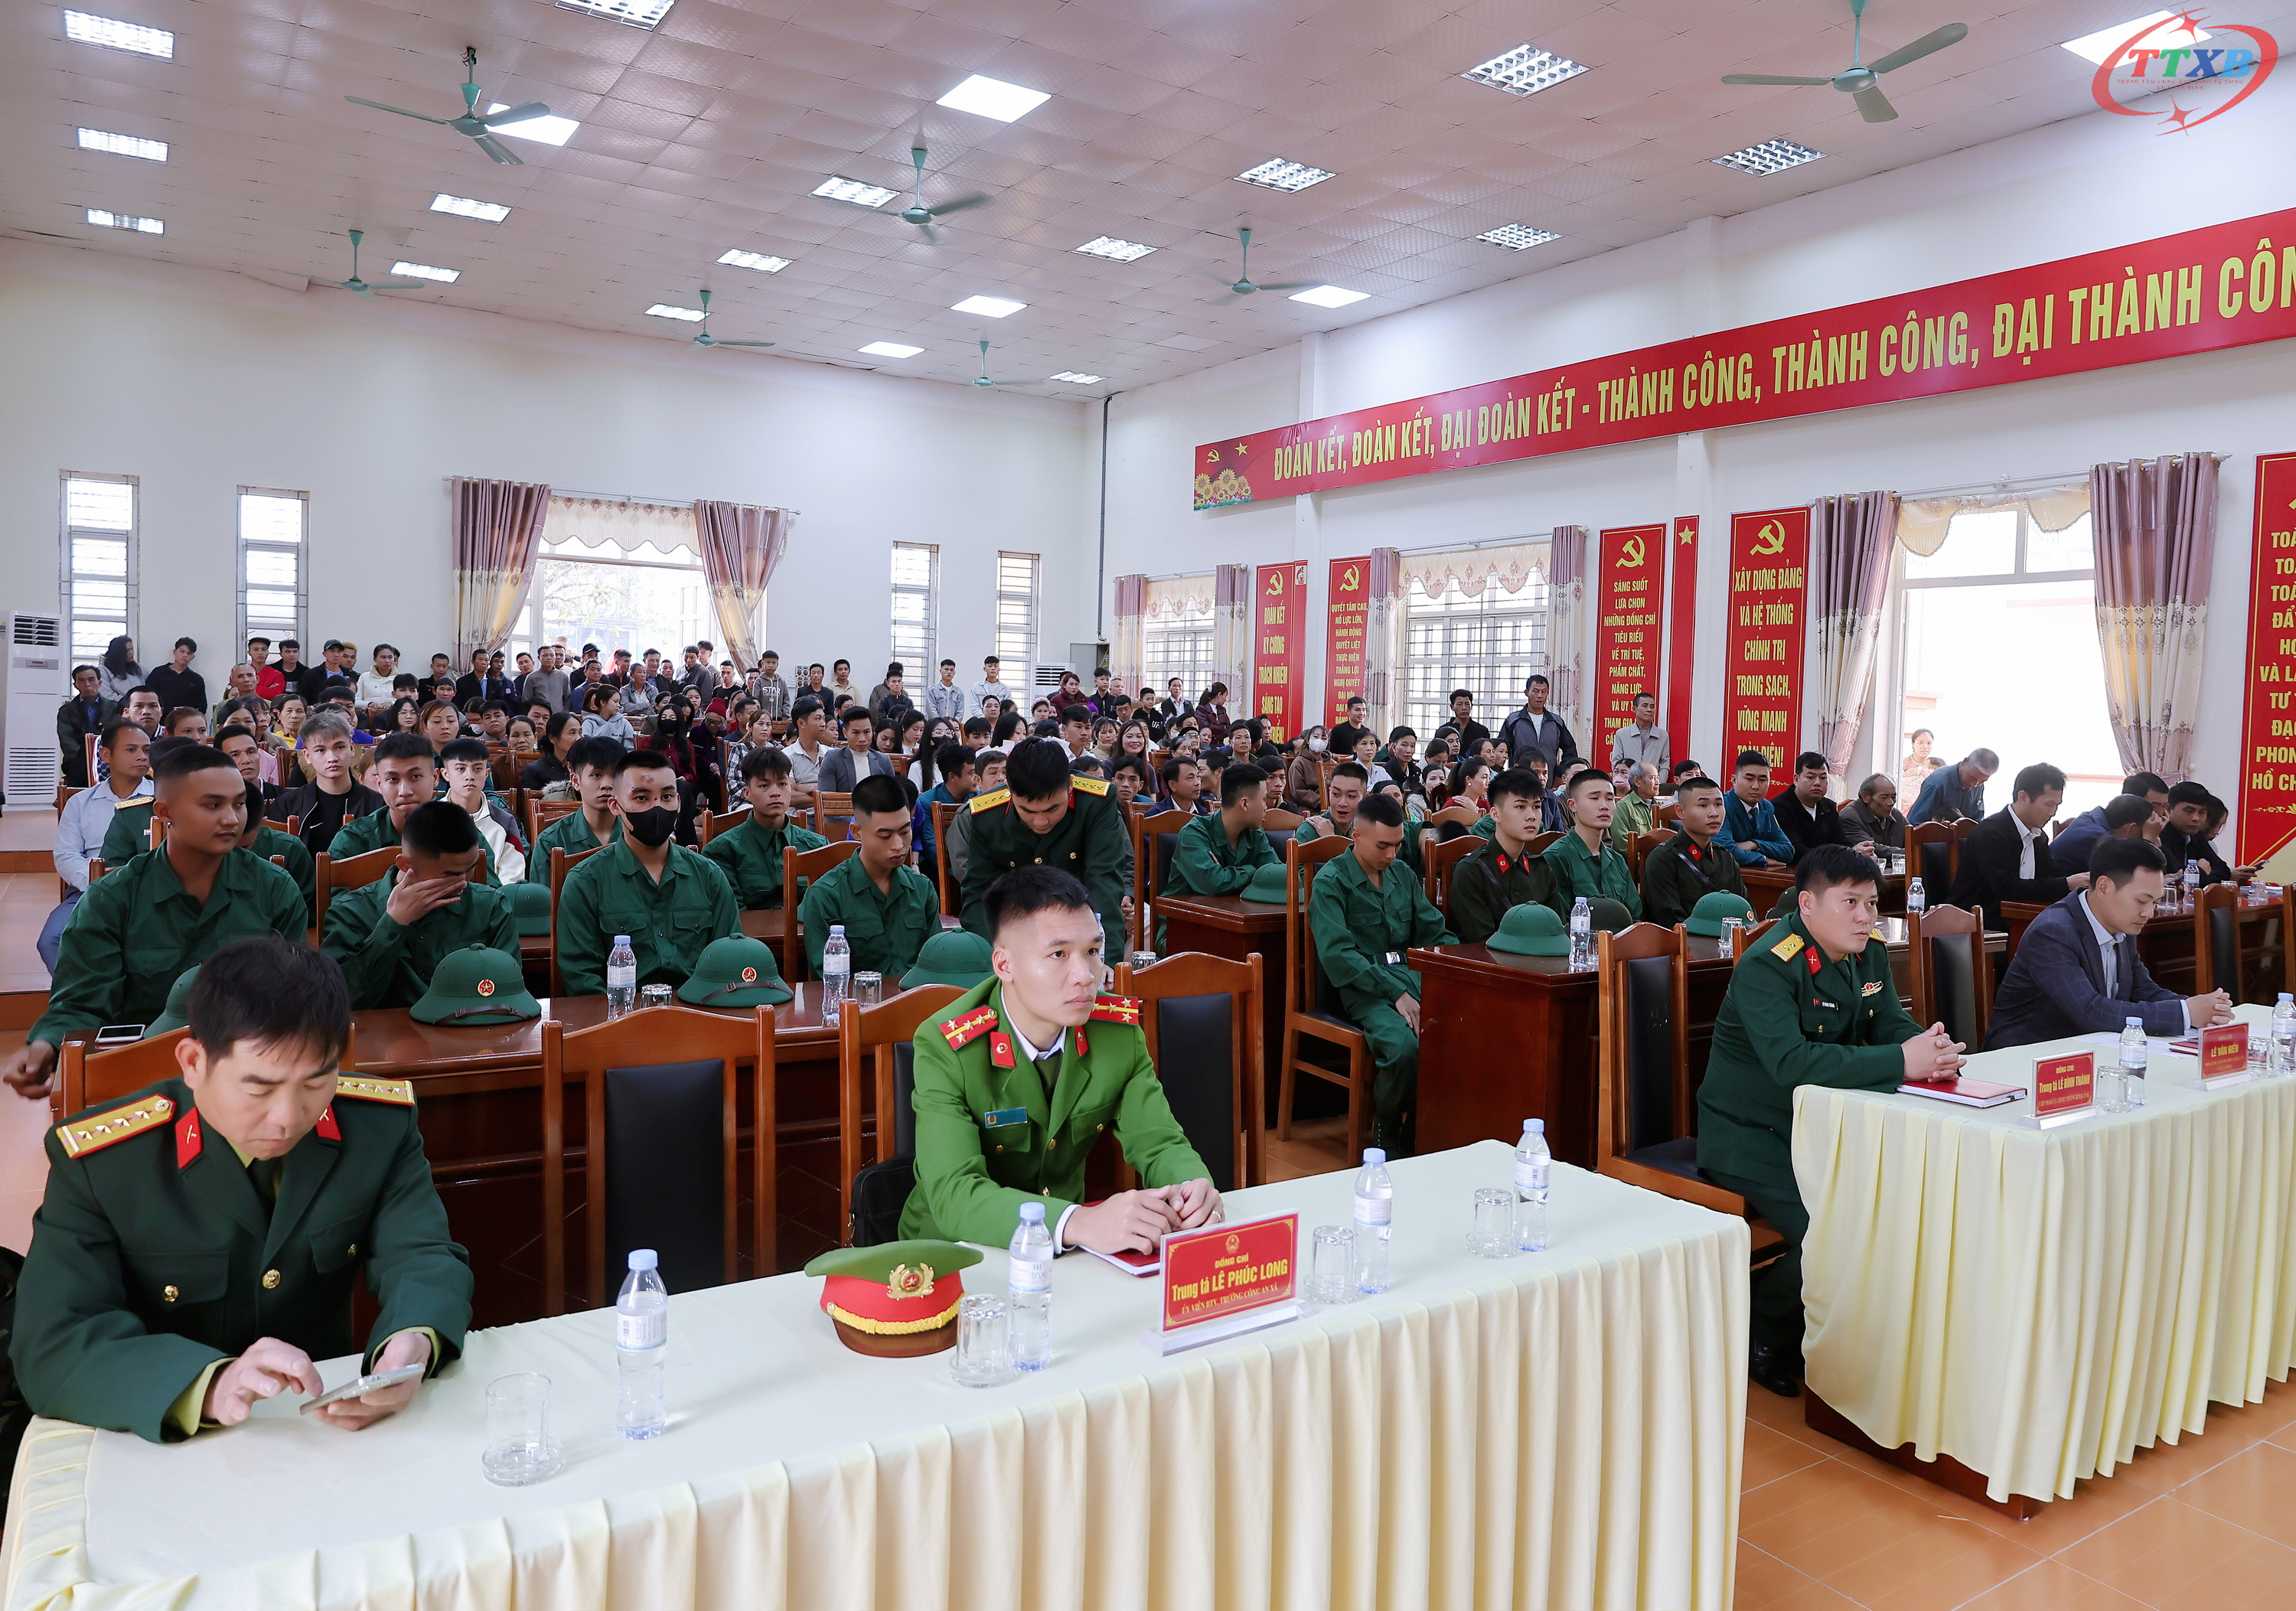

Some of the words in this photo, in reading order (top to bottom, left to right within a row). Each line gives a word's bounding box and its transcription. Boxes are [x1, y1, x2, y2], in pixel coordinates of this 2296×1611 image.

[1274, 437, 1313, 481] ĐOÀN
[1316, 425, 1347, 474] KẾT,
[1352, 419, 1396, 467] ĐOÀN
[1401, 406, 1435, 458] KẾT,
[1441, 409, 1472, 458] ĐẠI
[1477, 392, 1531, 445] ĐOÀN
[1537, 376, 1576, 435] KẾT
[1598, 366, 1675, 424] THÀNH
[1682, 350, 1761, 409] CÔNG,
[1773, 329, 1868, 394] THÀNH
[1879, 310, 1979, 377] CÔNG,
[1992, 294, 2055, 366] ĐẠI
[2068, 266, 2203, 344] THÀNH
[1613, 579, 1631, 592] SÁNG
[1632, 576, 1649, 592] SUỐT
[1734, 566, 1751, 592] XÂY
[1753, 567, 1776, 595] DỰNG
[1778, 559, 1802, 589] ĐẢNG
[1346, 602, 1356, 611] TÂM
[1615, 597, 1627, 611] LỰA
[1628, 597, 1645, 611] CHỌN
[1603, 613, 1625, 627] NHỮNG
[1626, 611, 1643, 626] ĐỒNG
[1645, 611, 1656, 625] CHÍ
[1740, 601, 1750, 626] VÀ
[1753, 600, 1763, 631] HỆ
[1766, 595, 1794, 625] THỐNG
[1614, 630, 1628, 643] TIÊU
[1629, 628, 1643, 643] BIỂU
[1611, 646, 1619, 660] VỀ
[1620, 647, 1630, 660] TRÍ
[1632, 647, 1645, 662] TUỆ,
[1744, 635, 1770, 661] CHÍNH
[1772, 639, 1786, 665] TRỊ
[1258, 662, 1273, 684] TRÁCH
[1609, 662, 1627, 677] PHẨM
[1628, 663, 1646, 678] CHẤT,
[2259, 662, 2280, 682] VÀ
[1611, 681, 1629, 694] NĂNG
[1630, 682, 1642, 696] LỰC
[1736, 674, 1763, 696] TRONG
[1765, 674, 1791, 701] SẠCH,
[1261, 692, 1274, 714] SÁNG
[1274, 696, 1283, 718] TẠO
[1611, 698, 1619, 711] VÀ
[1620, 700, 1629, 711] UY
[2269, 690, 2291, 709] TƯ
[1604, 717, 1621, 728] THAM
[1623, 718, 1633, 728] GIA
[1737, 704, 1760, 732] VỮNG
[1761, 710, 1788, 736] MẠNH
[2252, 768, 2274, 790] HỒ
[2039, 1082, 2053, 1094] Trung
[1215, 1257, 1235, 1269] ĐỒNG
[1237, 1253, 1249, 1264] CHÍ
[1172, 1283, 1199, 1301] Trung
[1201, 1277, 1210, 1294] tá
[1212, 1271, 1225, 1292] LÊ
[1228, 1266, 1257, 1288] PHÚC
[1261, 1259, 1288, 1280] LONG
